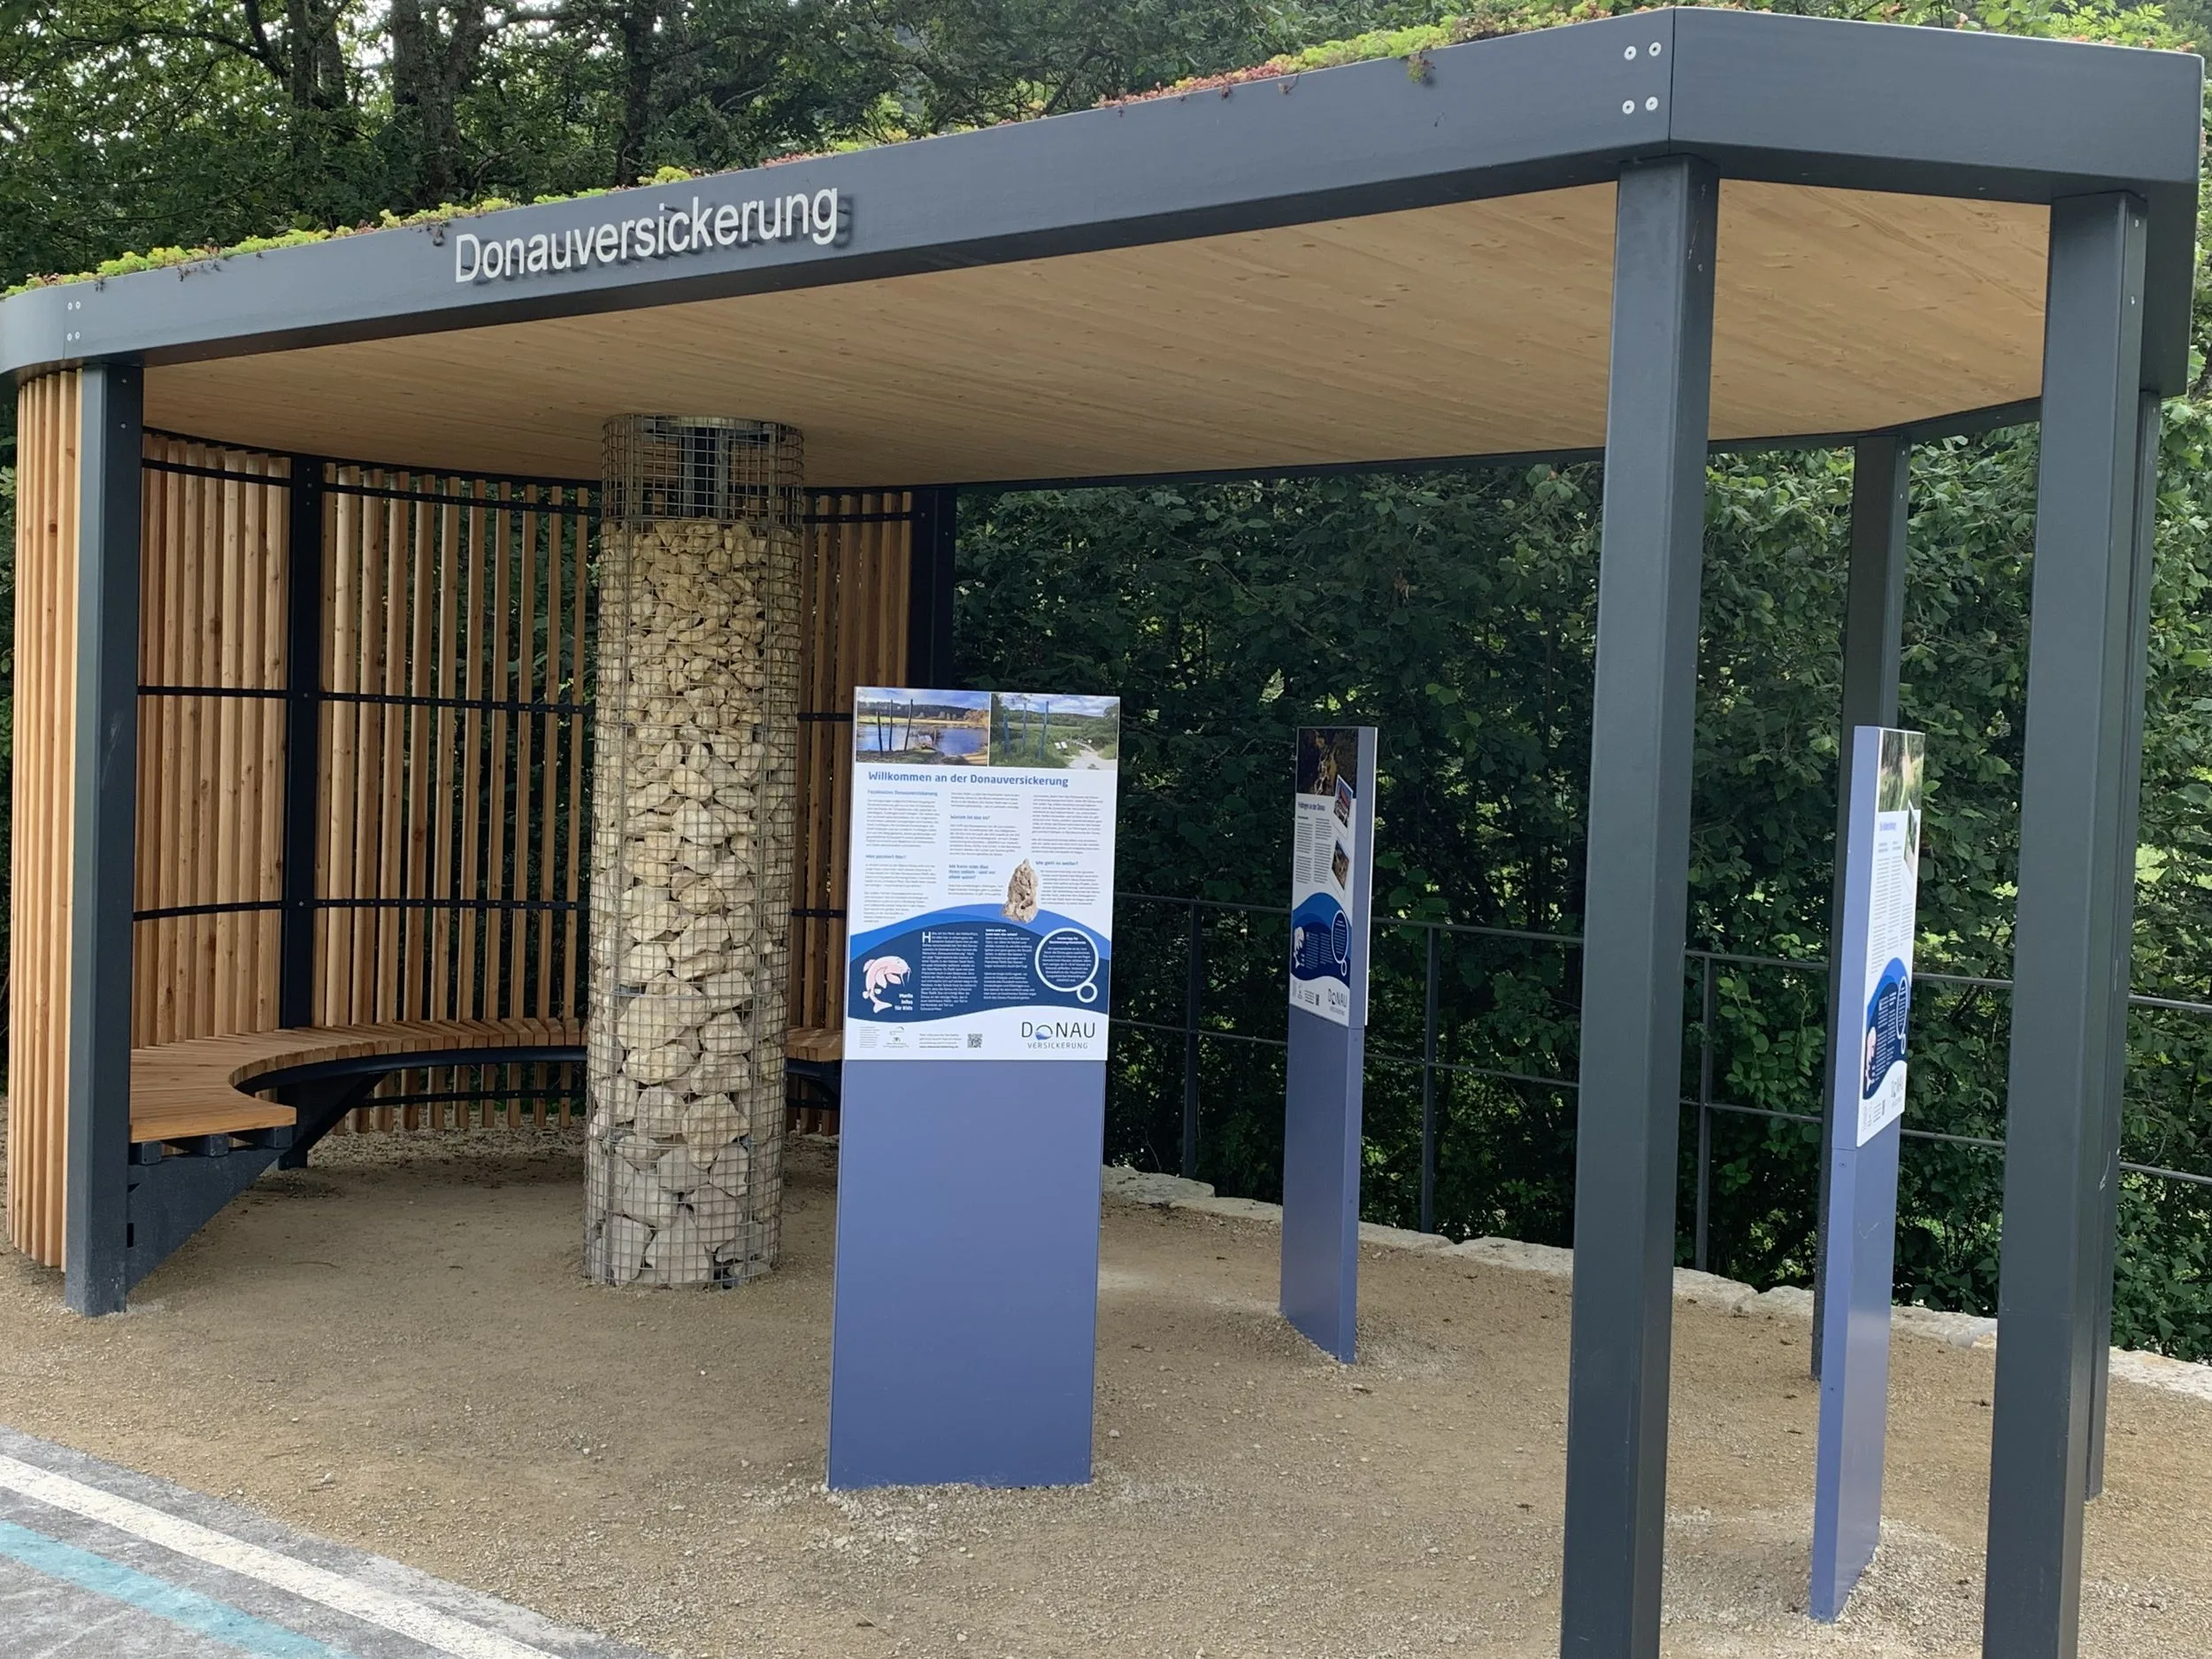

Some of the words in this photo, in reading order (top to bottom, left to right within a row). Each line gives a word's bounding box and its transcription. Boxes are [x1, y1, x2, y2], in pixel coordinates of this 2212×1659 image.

[456, 188, 838, 283] Donauversickerung
[868, 771, 932, 782] Willkommen
[950, 774, 967, 783] der
[970, 774, 1069, 787] Donauversickerung
[1021, 1021, 1095, 1041] DONAU
